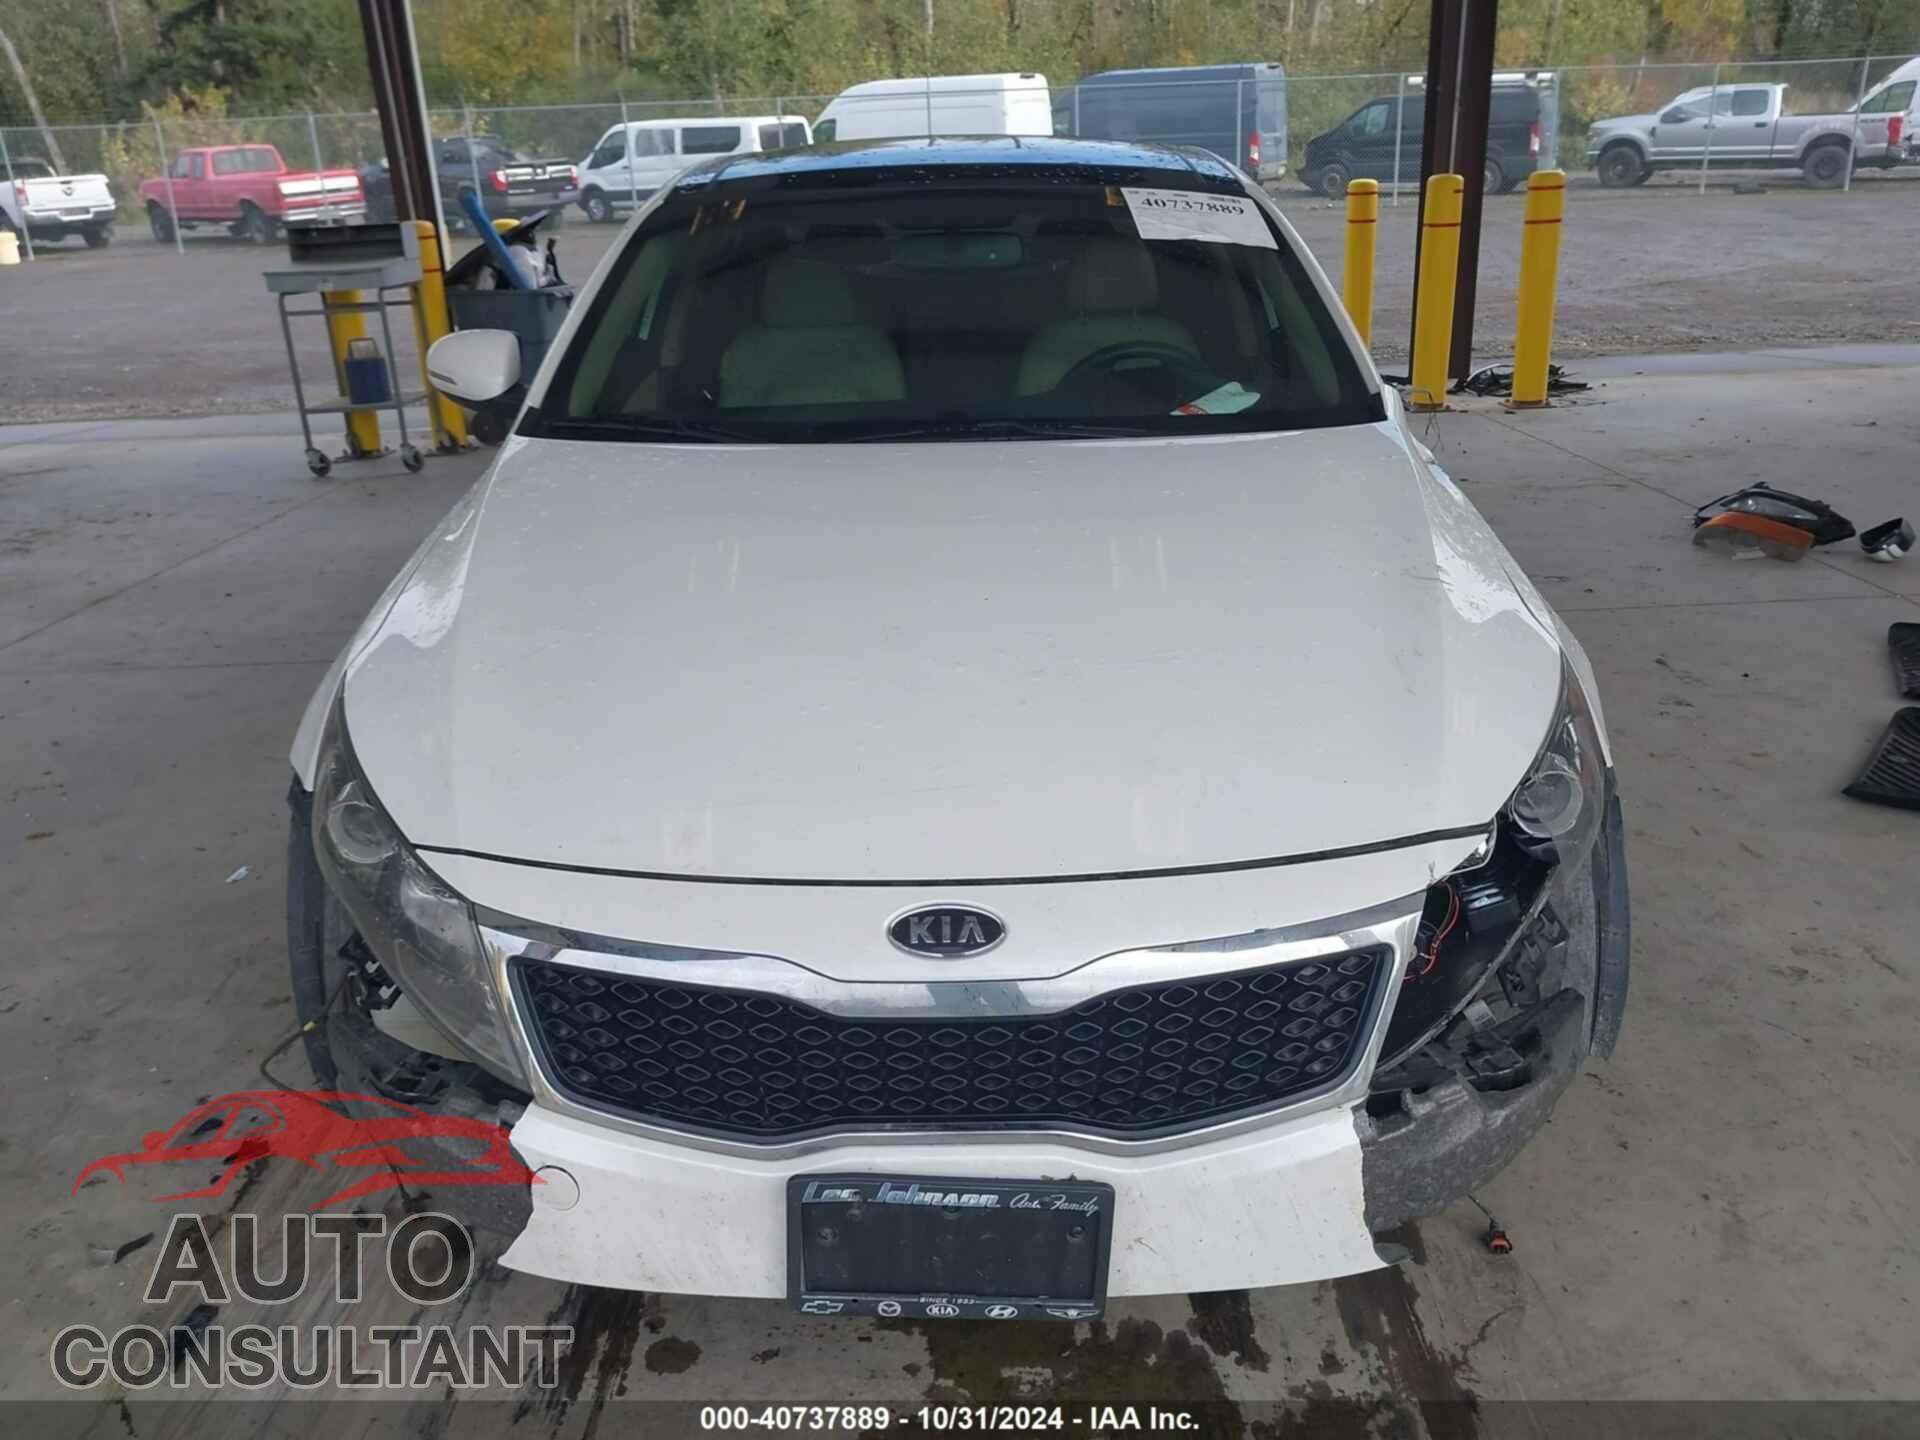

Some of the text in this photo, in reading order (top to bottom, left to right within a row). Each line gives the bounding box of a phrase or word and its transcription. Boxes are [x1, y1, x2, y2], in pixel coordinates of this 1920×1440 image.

[1141, 197, 1245, 215] 40737889
[908, 915, 987, 944] KIA
[1050, 1193, 1100, 1217] Family
[931, 1305, 953, 1315] KIA
